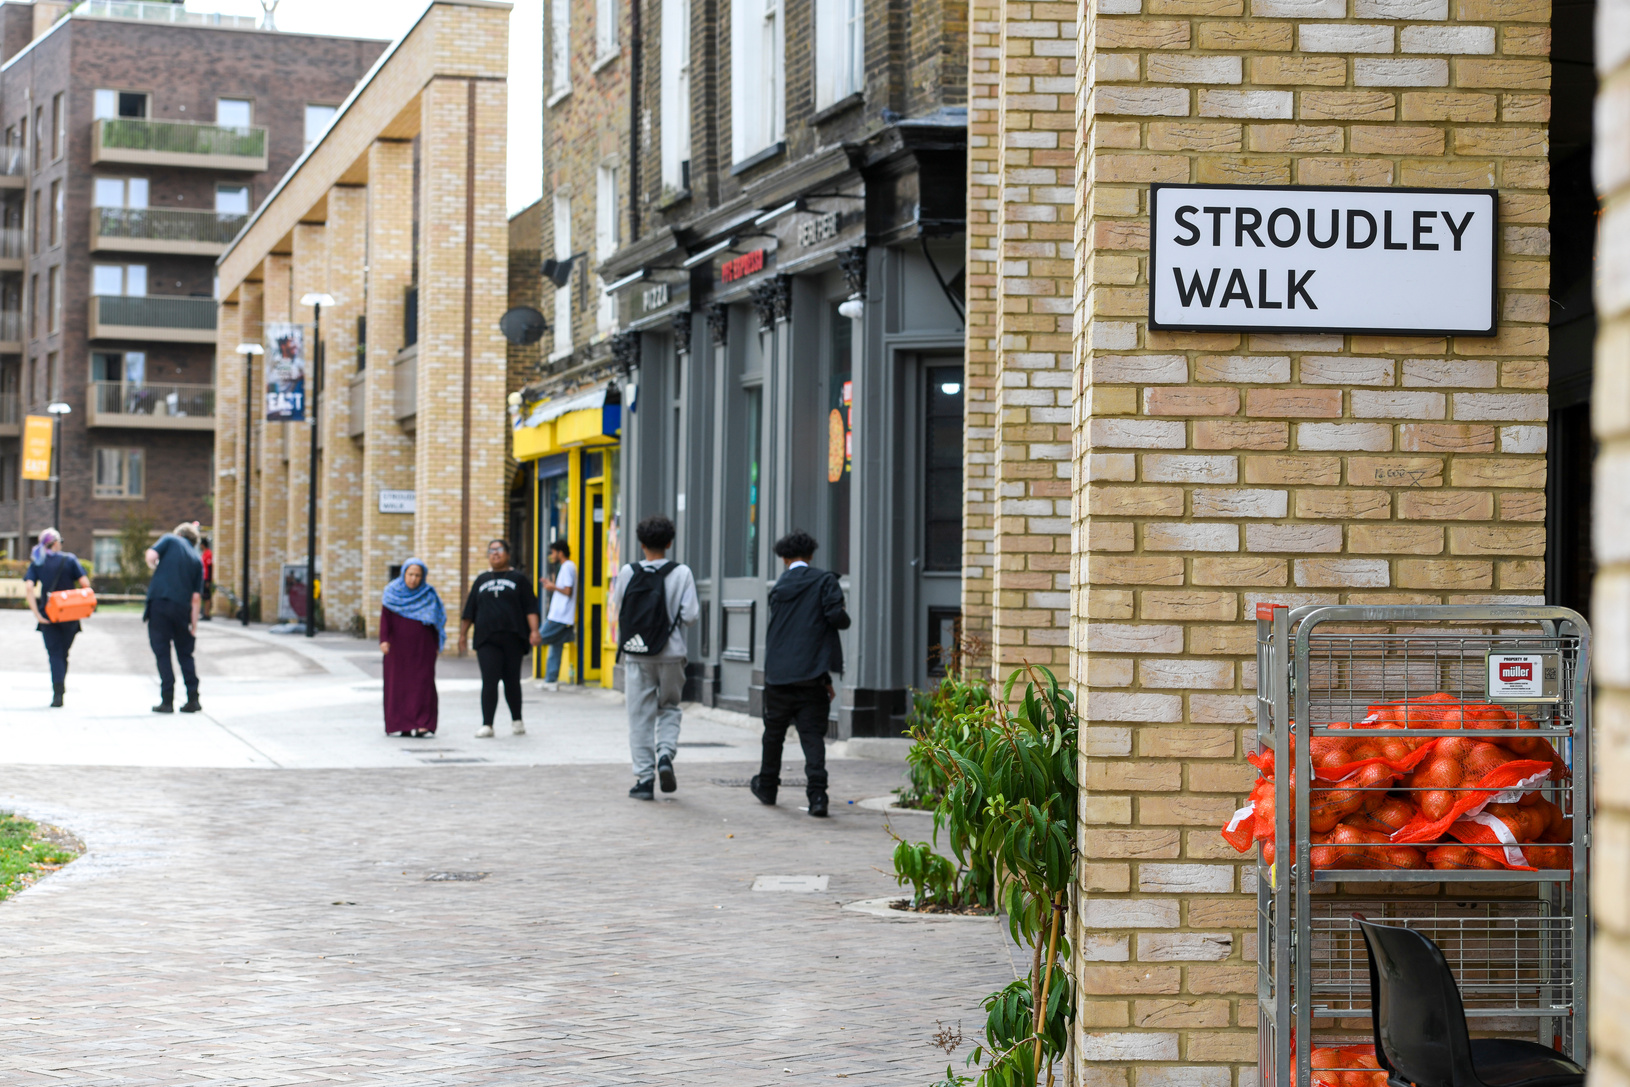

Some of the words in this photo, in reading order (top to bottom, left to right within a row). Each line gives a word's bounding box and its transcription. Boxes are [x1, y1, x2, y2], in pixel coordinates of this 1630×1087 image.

[1172, 205, 1475, 252] STROUDLEY
[643, 283, 669, 312] PIZZA
[1172, 267, 1318, 310] WALK
[267, 392, 303, 411] EAST
[1502, 665, 1530, 677] müller
